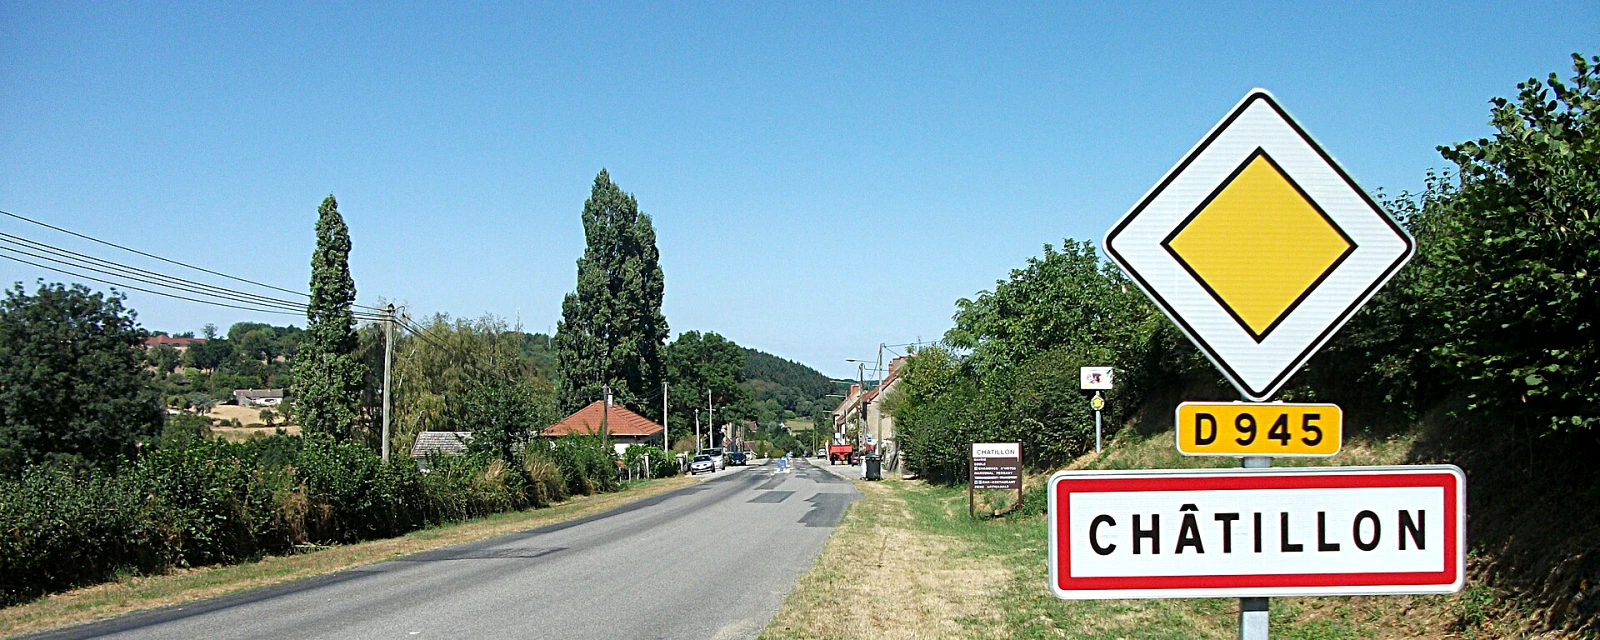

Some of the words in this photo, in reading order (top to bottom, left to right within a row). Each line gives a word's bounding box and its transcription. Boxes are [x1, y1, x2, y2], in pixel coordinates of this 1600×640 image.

[1195, 413, 1218, 446] D
[1234, 413, 1323, 446] 945
[1089, 503, 1426, 556] CHÂTILLON
